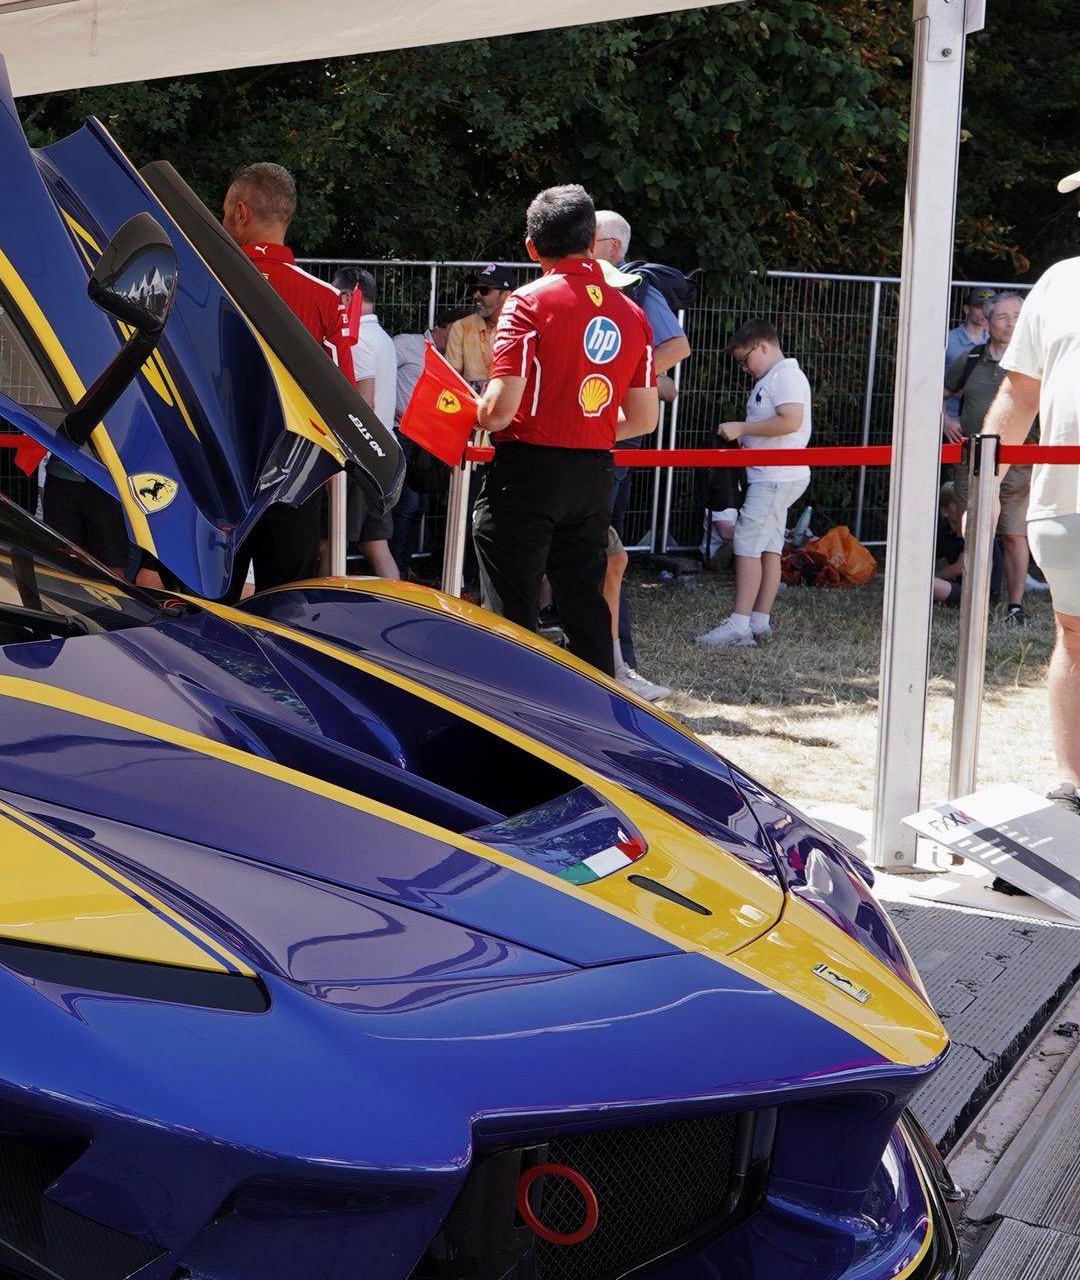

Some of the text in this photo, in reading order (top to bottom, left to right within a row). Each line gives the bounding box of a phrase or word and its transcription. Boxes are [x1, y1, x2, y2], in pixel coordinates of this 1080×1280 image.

[587, 318, 618, 362] hp
[348, 413, 386, 458] NO STEP
